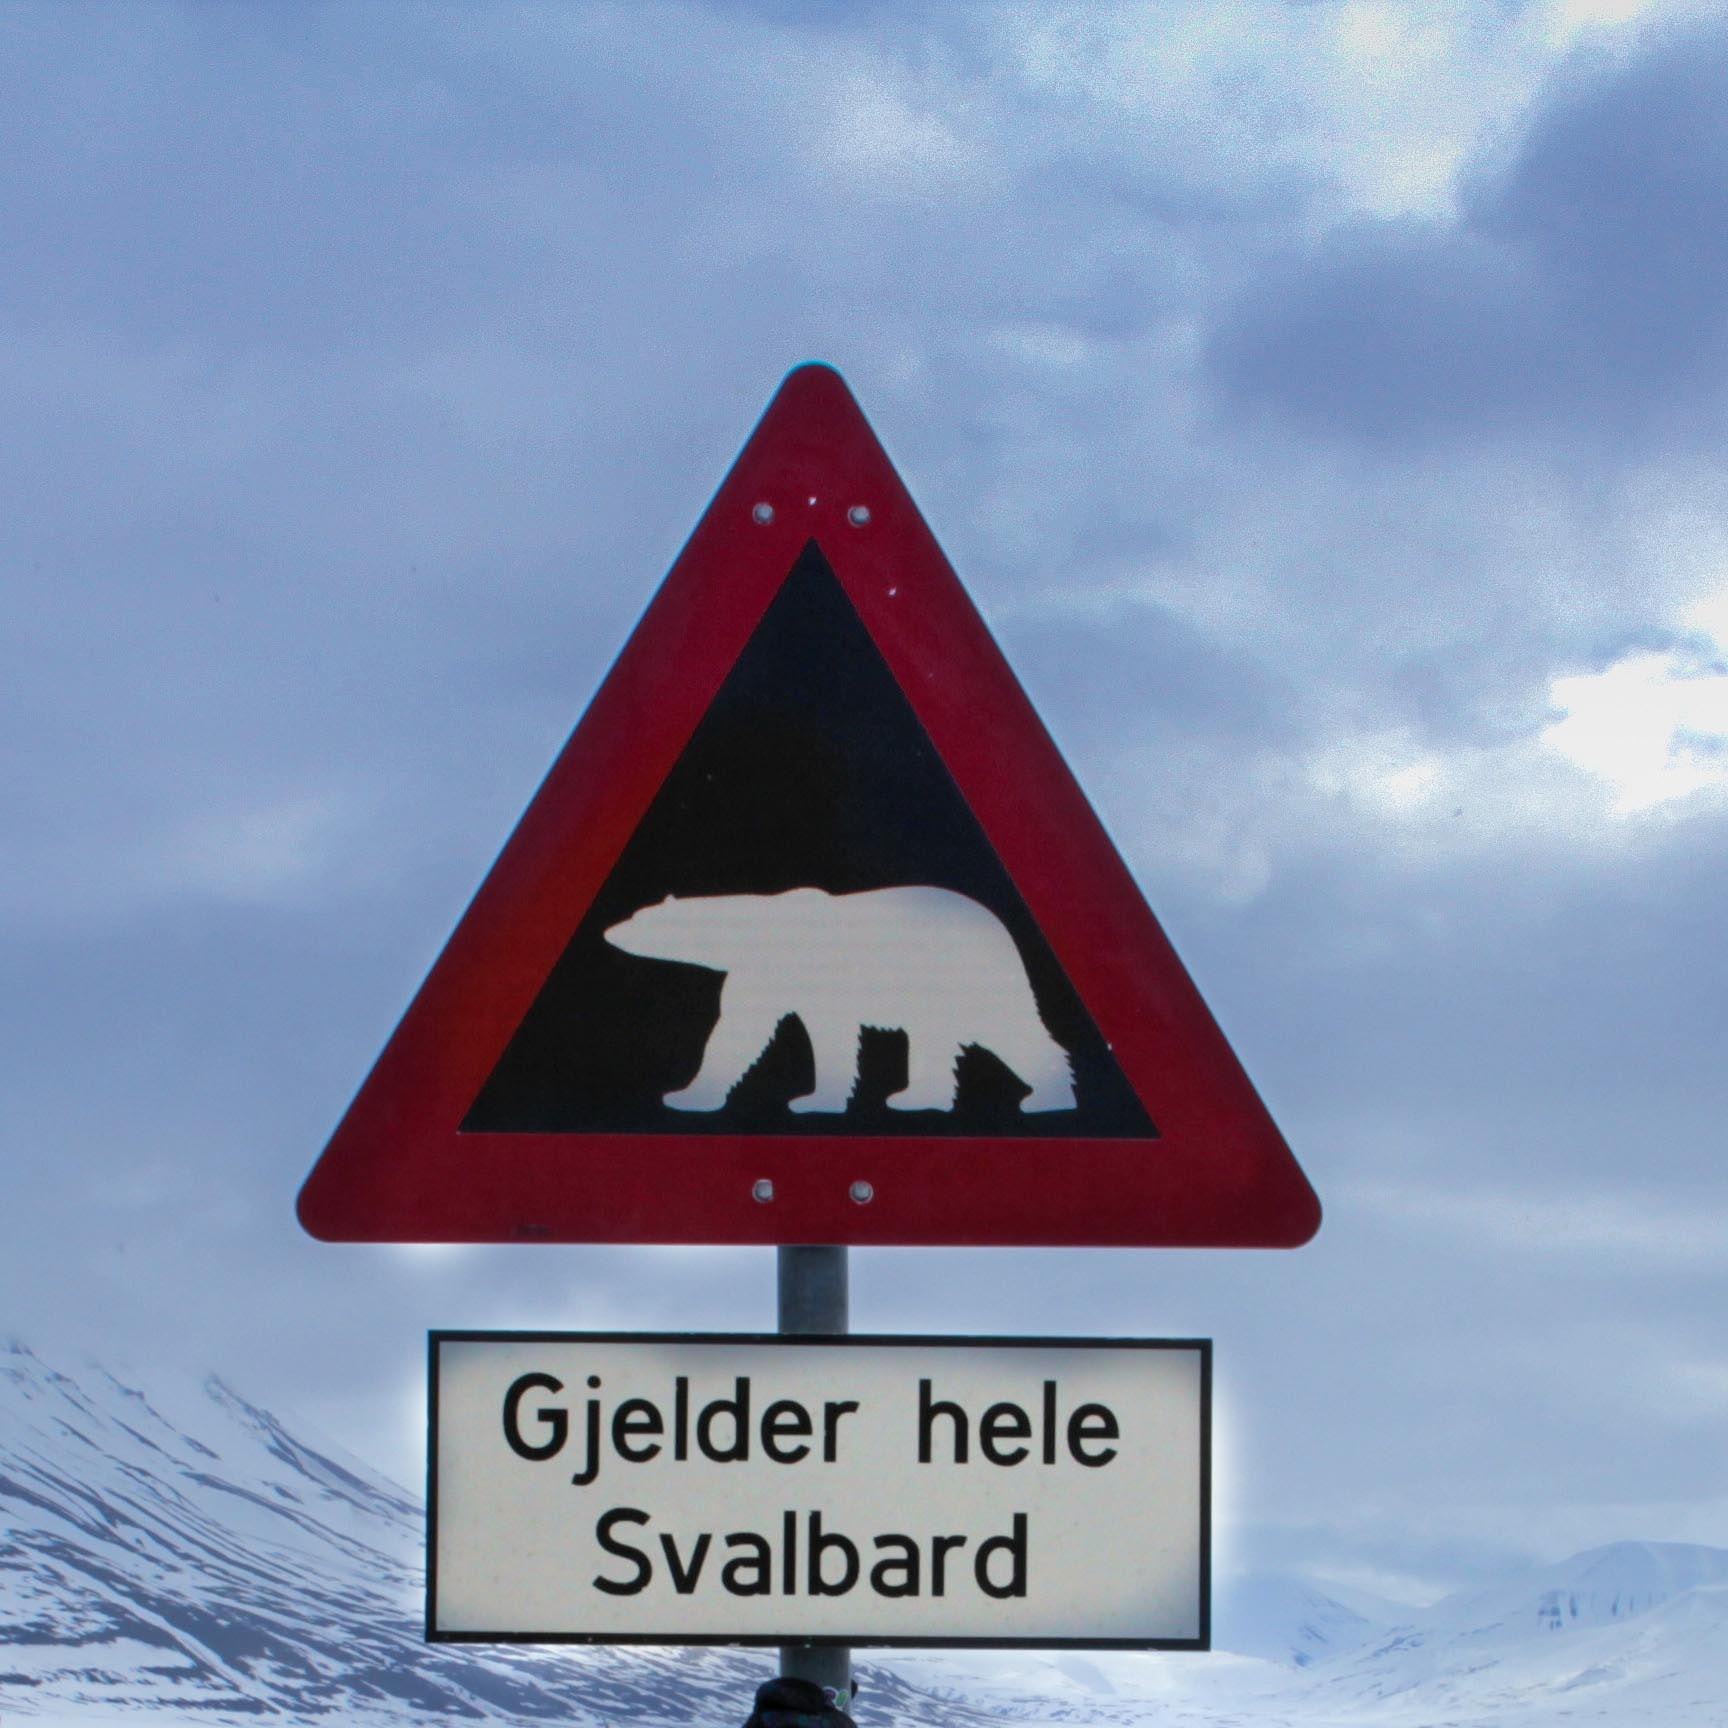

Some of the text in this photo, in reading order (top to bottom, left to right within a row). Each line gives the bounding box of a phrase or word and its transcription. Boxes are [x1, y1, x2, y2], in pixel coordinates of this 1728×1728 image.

[502, 1372, 1121, 1487] Gjelder hele
[592, 1507, 1028, 1600] Svalbard
